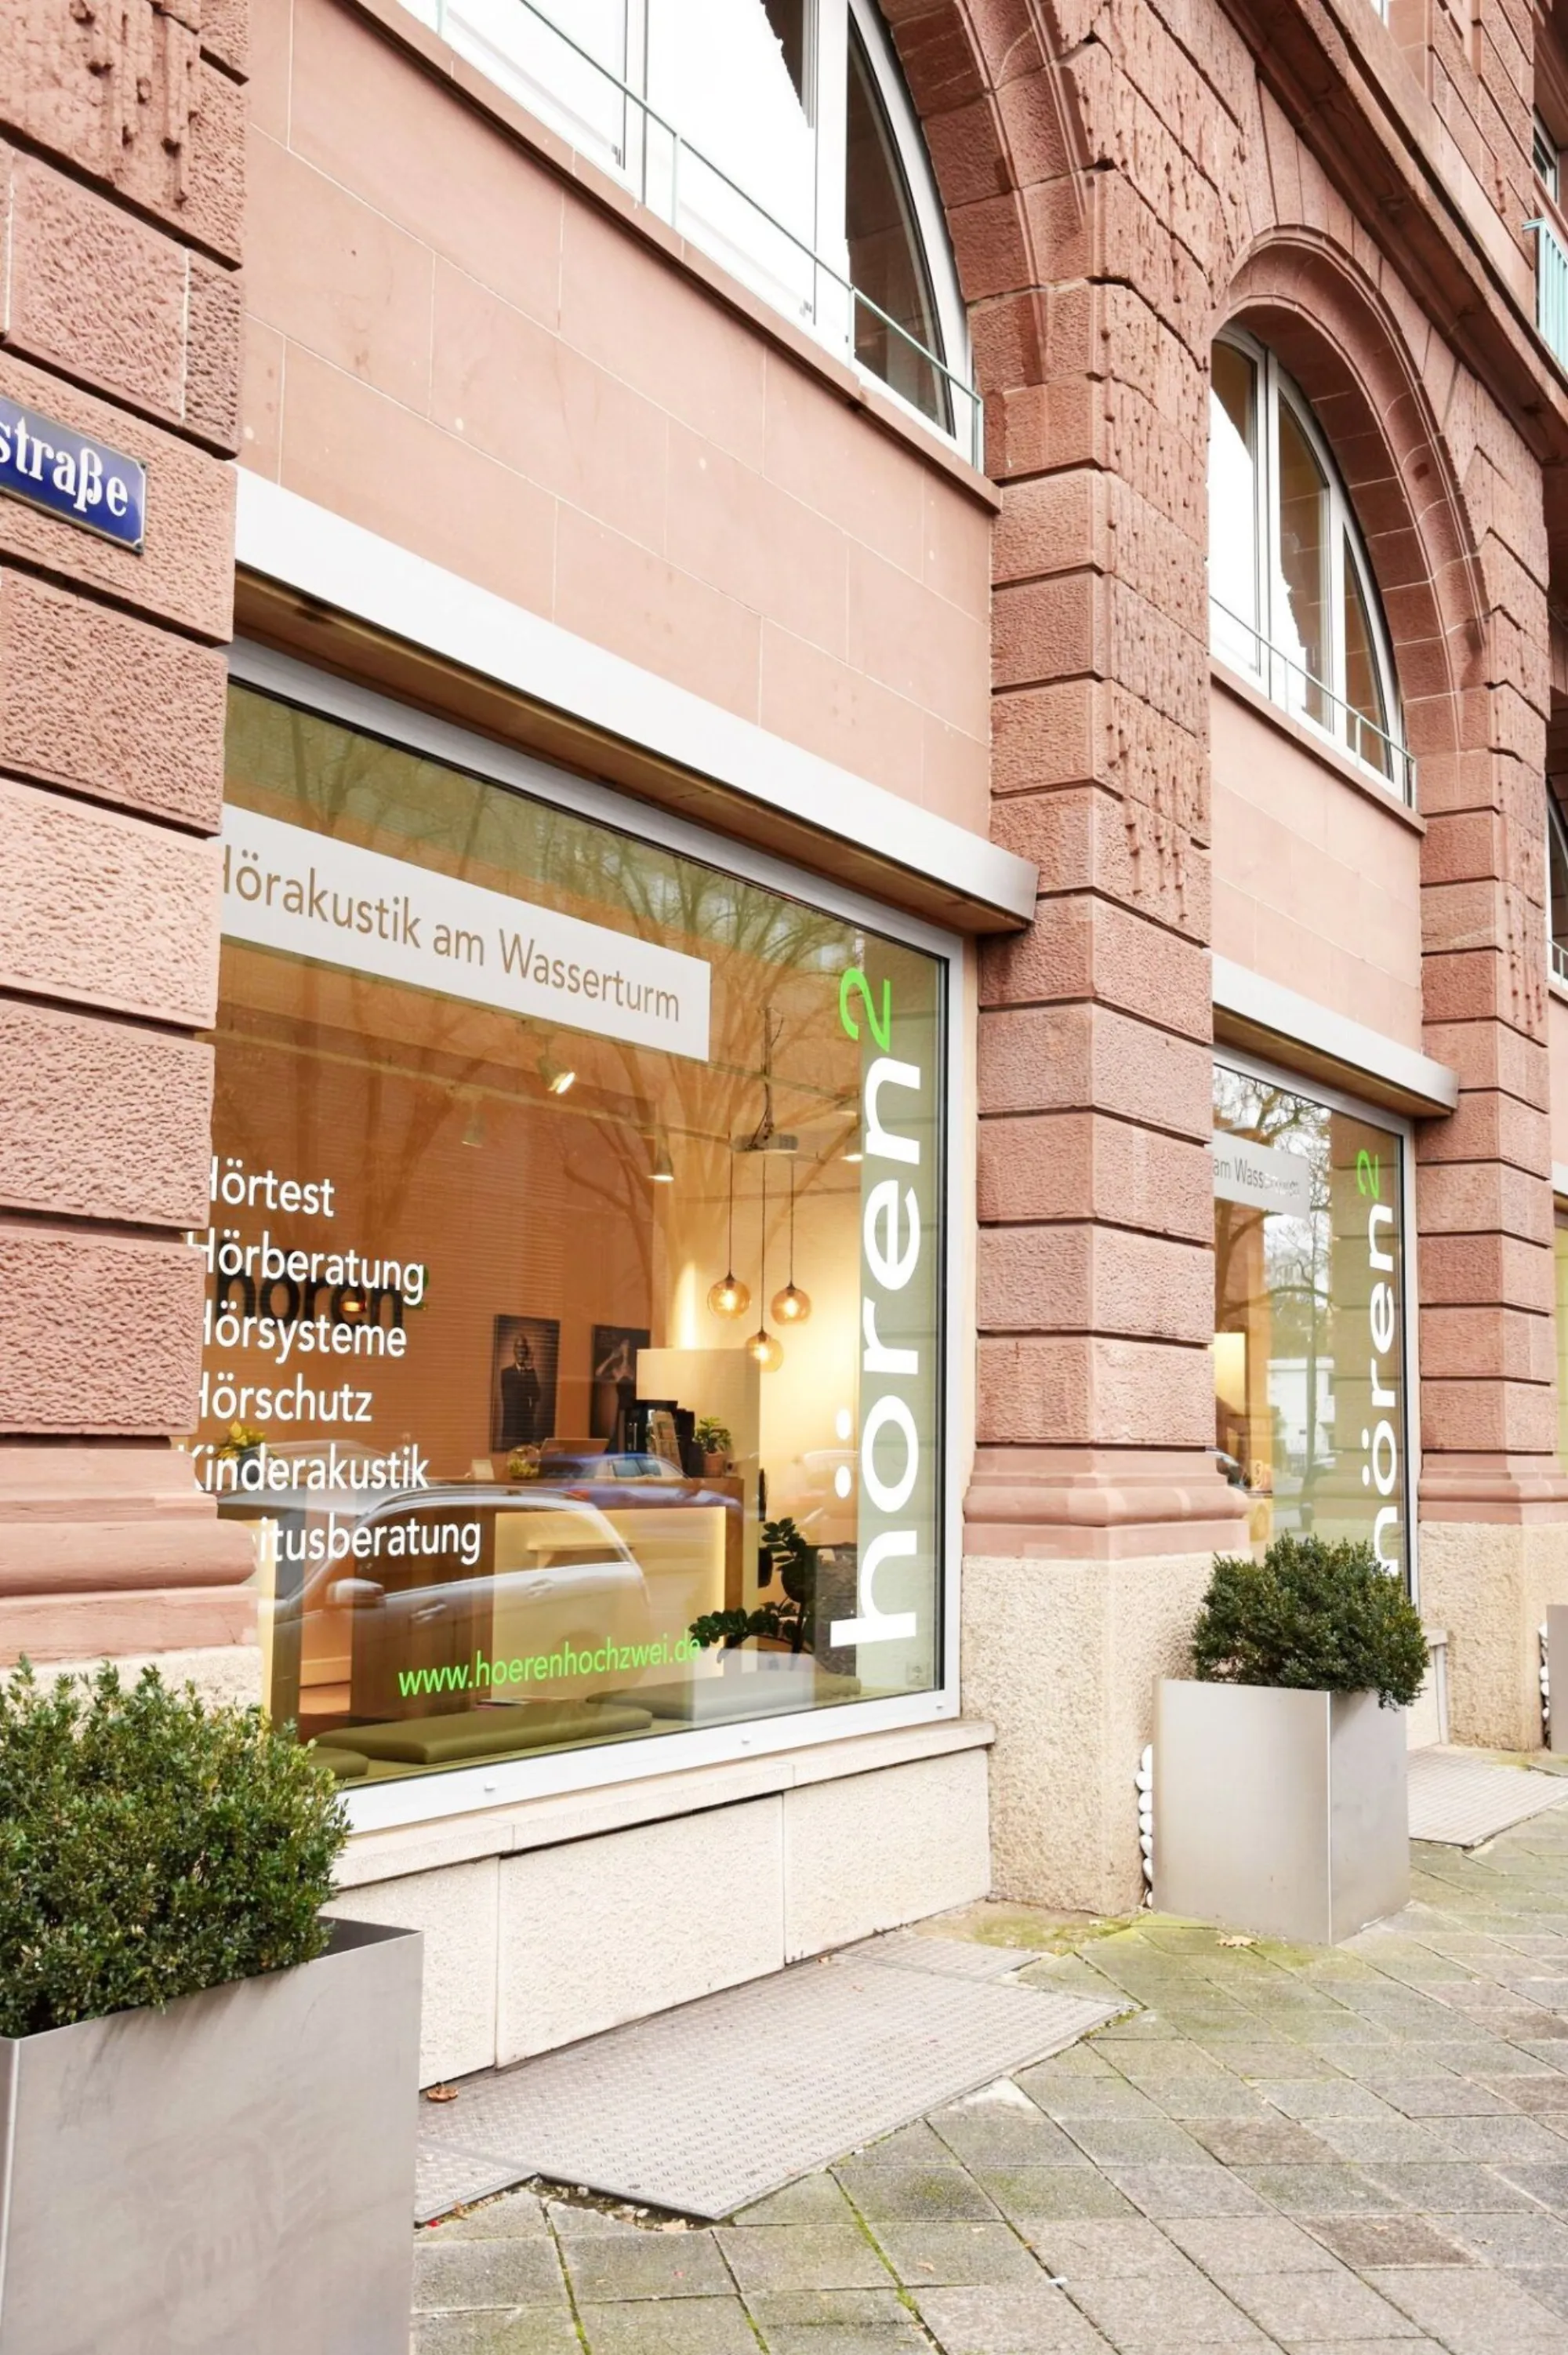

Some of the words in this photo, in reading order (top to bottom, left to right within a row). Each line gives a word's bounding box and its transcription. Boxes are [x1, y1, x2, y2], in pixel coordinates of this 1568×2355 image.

[433, 923, 485, 965] am
[499, 928, 680, 1022] Wasserturm
[252, 1512, 481, 1565] itusberatung
[397, 1628, 701, 1697] www.hoerenhochzwei.de
